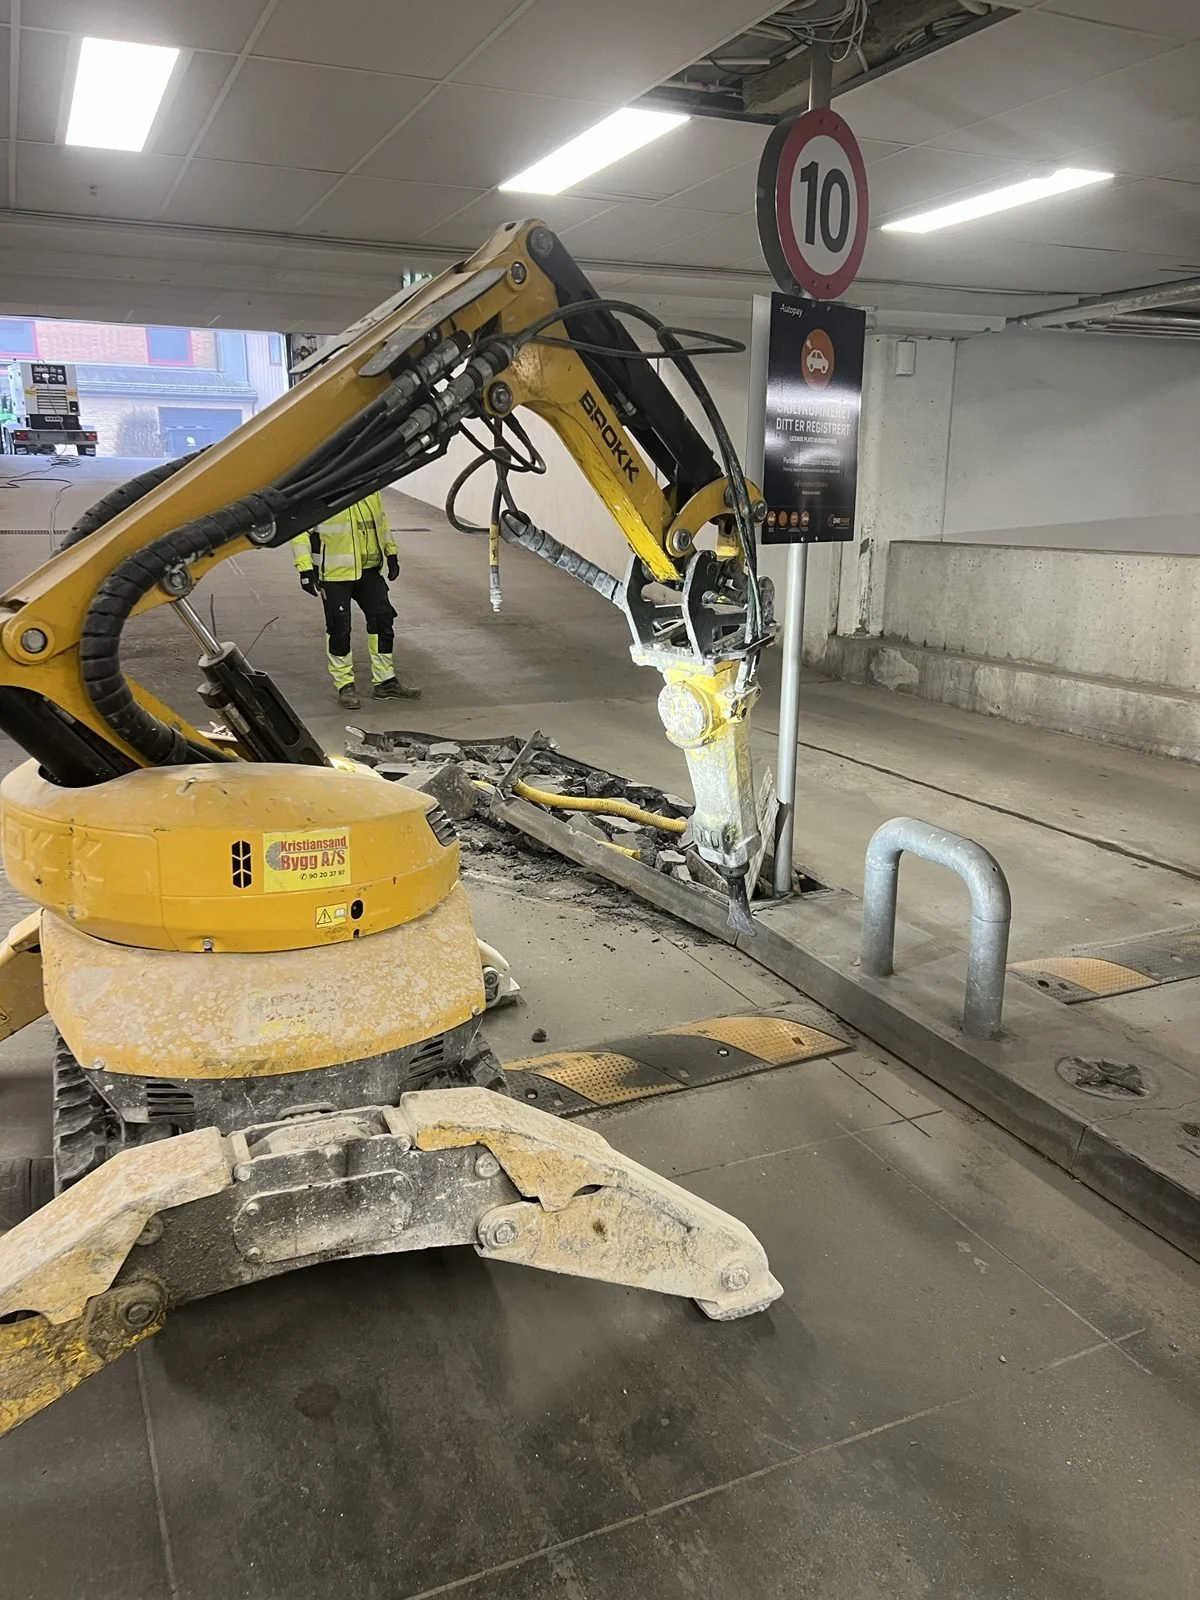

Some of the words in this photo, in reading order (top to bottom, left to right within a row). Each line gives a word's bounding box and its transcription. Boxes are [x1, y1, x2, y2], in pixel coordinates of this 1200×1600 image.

[800, 161, 851, 253] 10
[779, 303, 803, 318] Autopay
[776, 417, 794, 431] DITT
[794, 419, 805, 432] ER
[806, 420, 851, 436] REGISTRERT
[579, 390, 640, 484] BROKK
[281, 836, 346, 851] Kristiansand
[280, 854, 318, 871] Bygg
[321, 850, 346, 867] A/S
